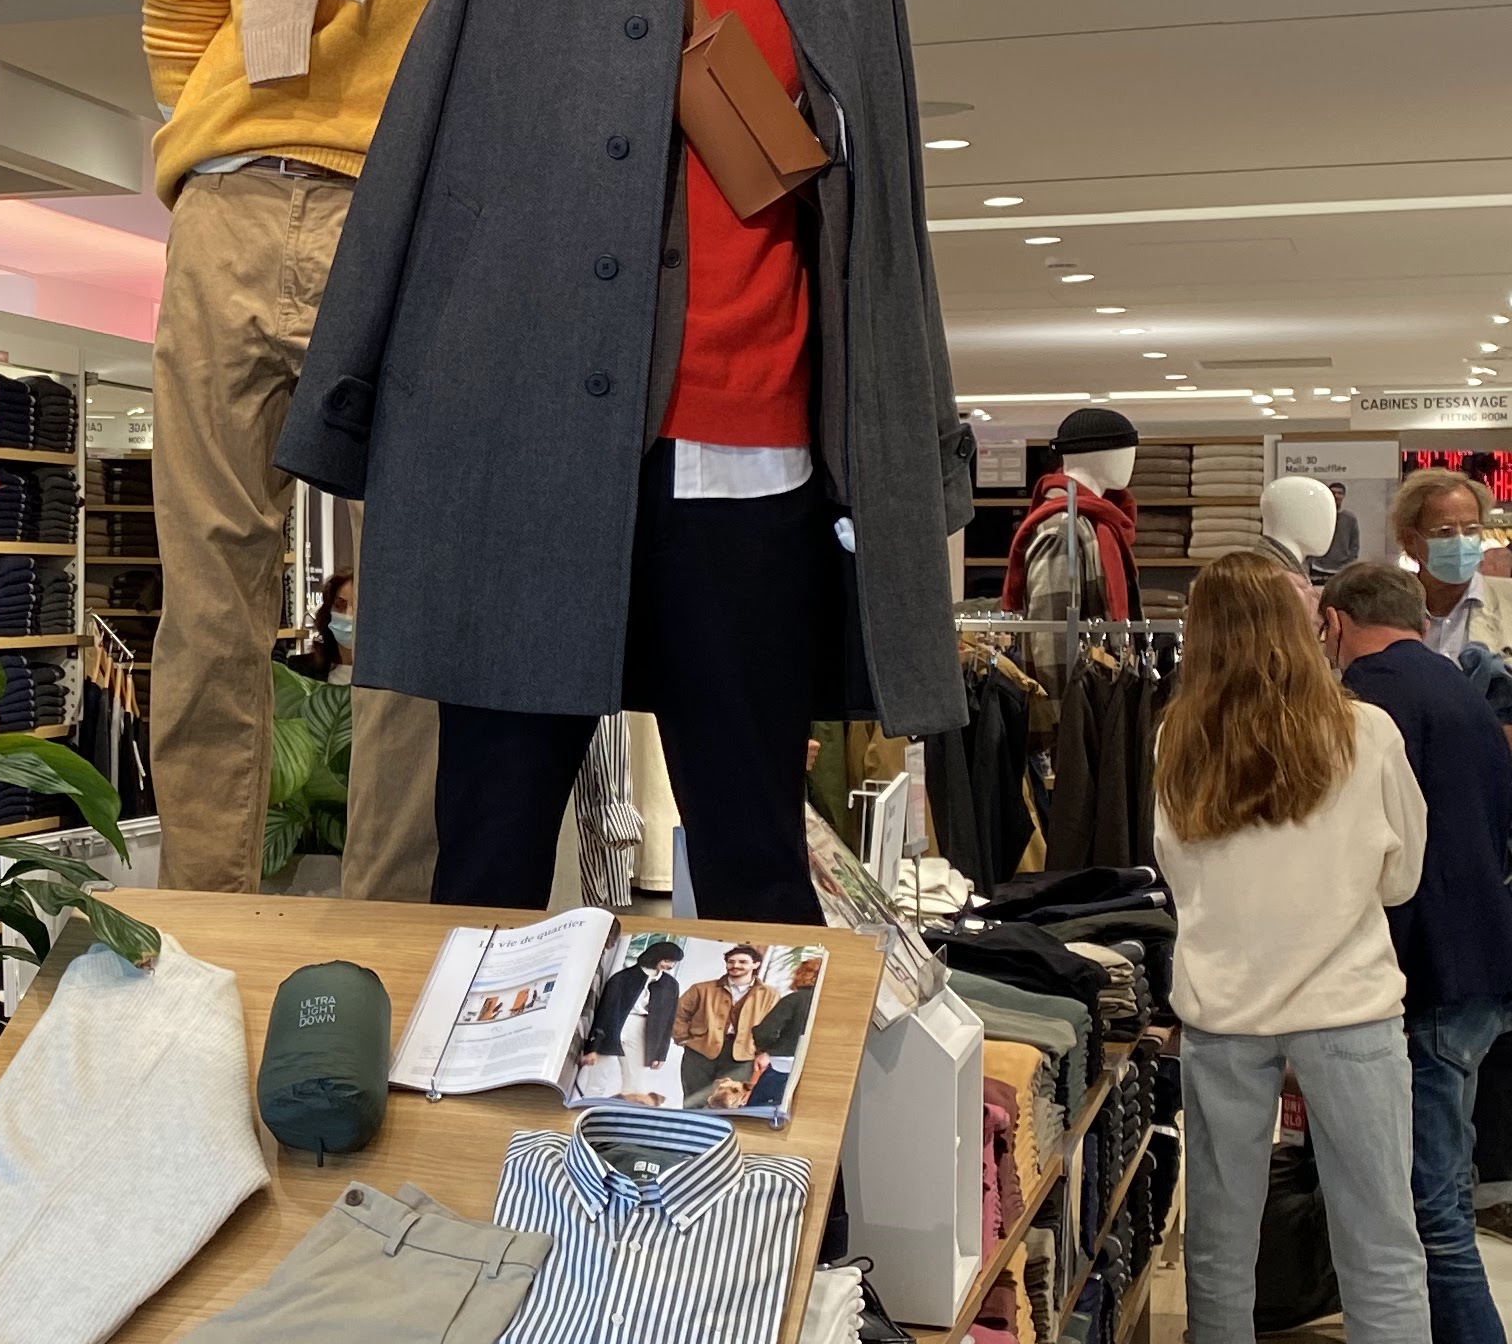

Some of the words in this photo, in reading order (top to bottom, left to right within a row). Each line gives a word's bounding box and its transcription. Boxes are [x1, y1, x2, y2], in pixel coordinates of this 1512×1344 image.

[1360, 397, 1418, 410] CABINES
[1424, 396, 1508, 409] D'ESSAYAGE
[1440, 413, 1477, 422] FITTING
[1481, 412, 1508, 421] ROOM
[499, 939, 517, 948] vie
[520, 935, 534, 945] de
[536, 920, 587, 941] quartier
[300, 995, 337, 1009] ULTRA
[299, 1004, 336, 1018] LIGHT
[299, 1014, 336, 1028] DOWN
